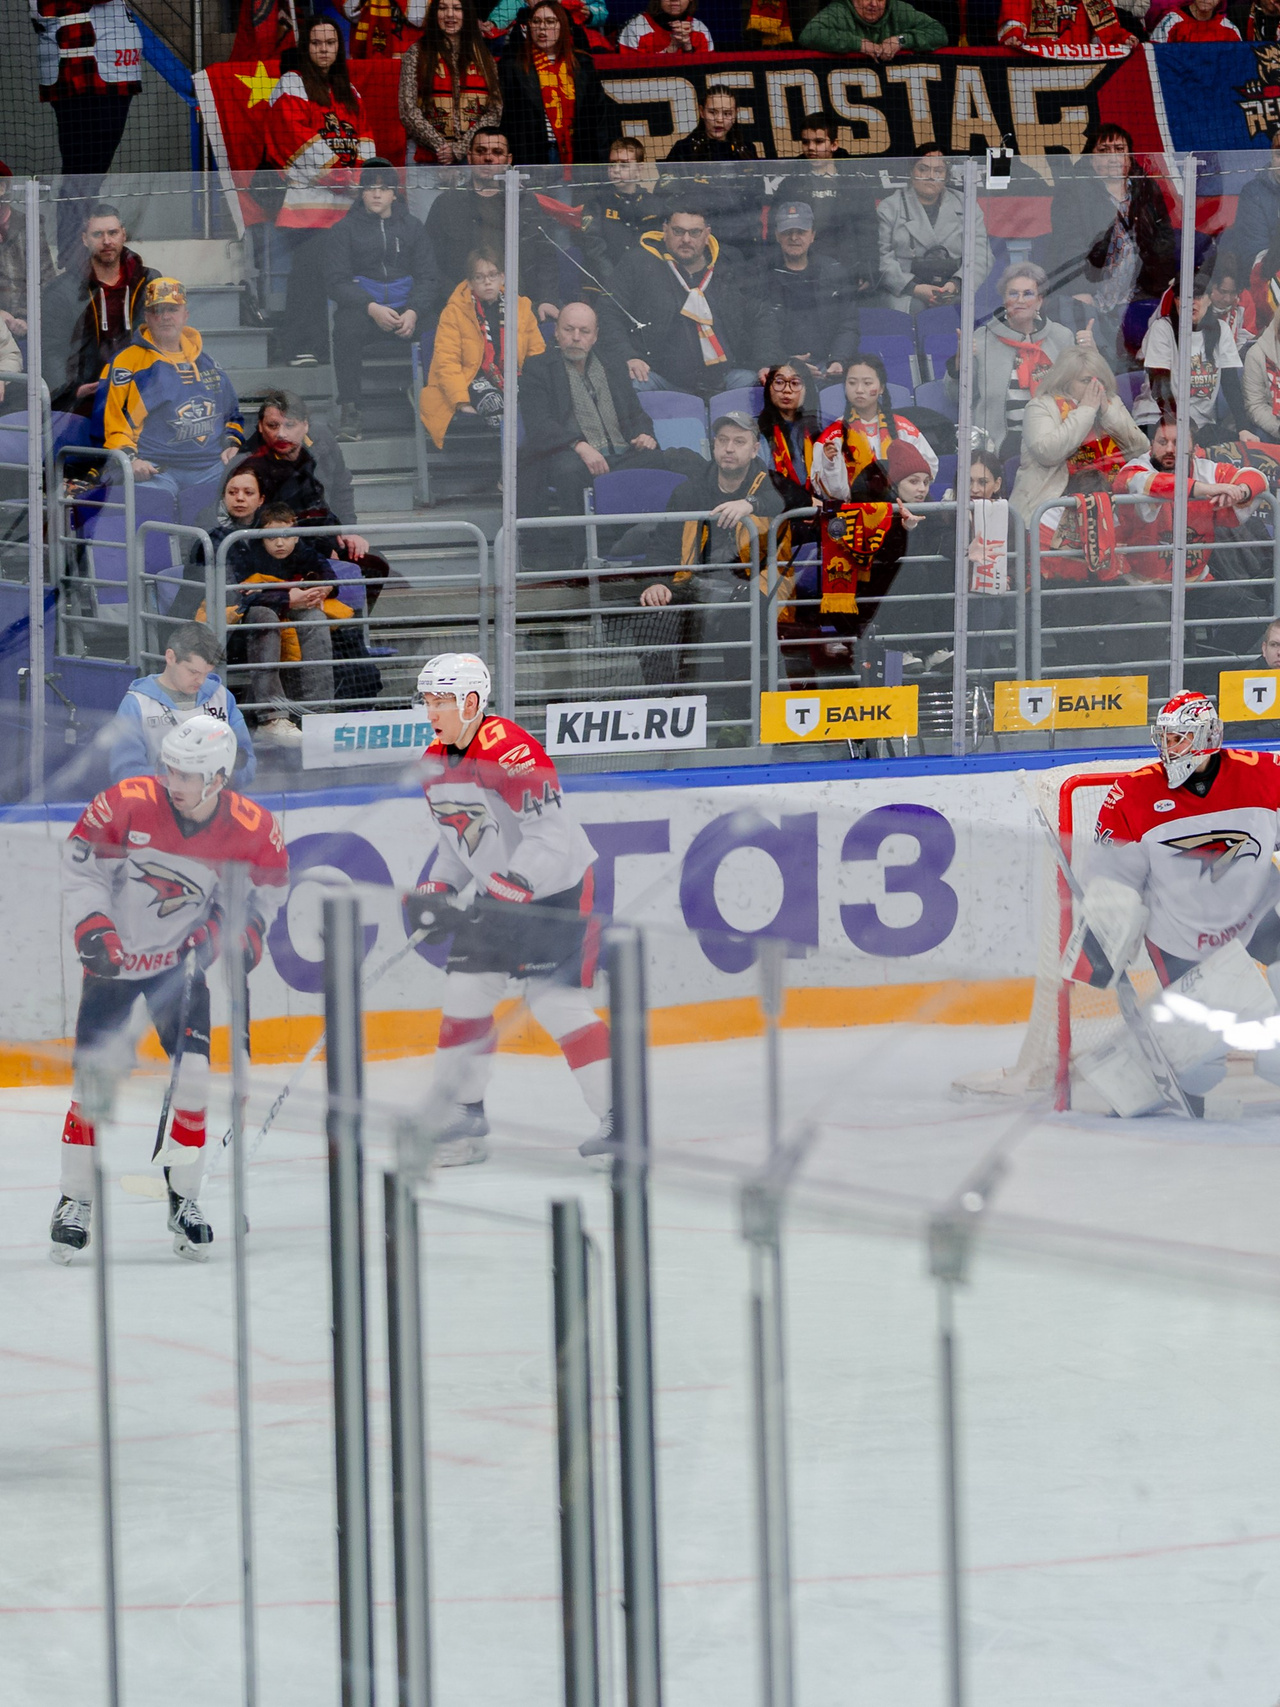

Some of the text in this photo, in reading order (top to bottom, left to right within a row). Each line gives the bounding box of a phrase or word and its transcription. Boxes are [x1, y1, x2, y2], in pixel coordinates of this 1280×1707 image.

[827, 704, 892, 724] БАНК
[1058, 693, 1122, 712] БАНК
[333, 722, 435, 752] SIBUR
[556, 706, 696, 745] KHL.RU
[522, 780, 562, 816] 44
